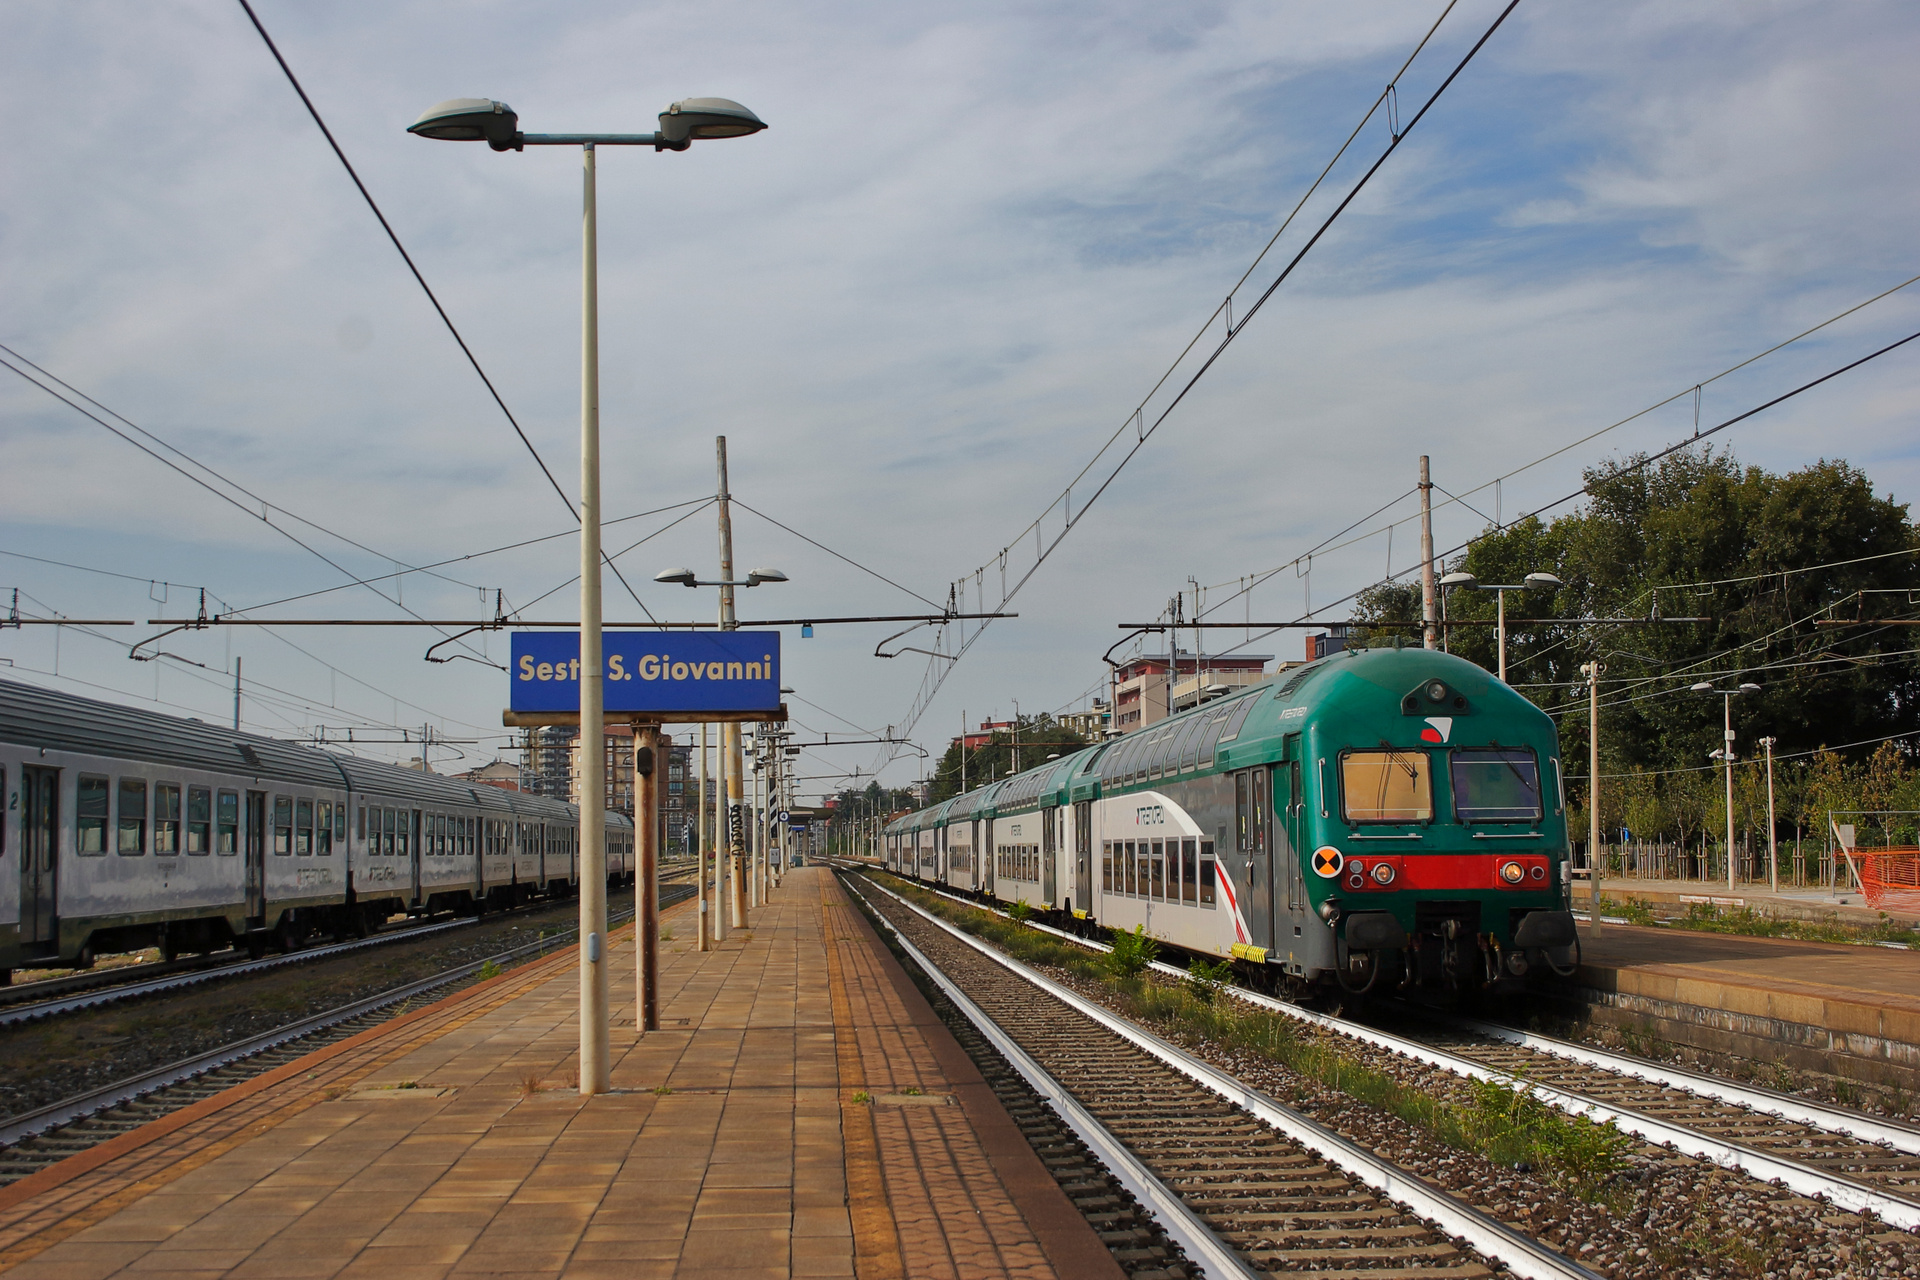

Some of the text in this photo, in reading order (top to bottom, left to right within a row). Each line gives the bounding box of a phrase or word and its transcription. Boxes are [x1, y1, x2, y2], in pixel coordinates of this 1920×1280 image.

[519, 654, 772, 682] Sest S. Giovanni
[10, 791, 19, 810] 2
